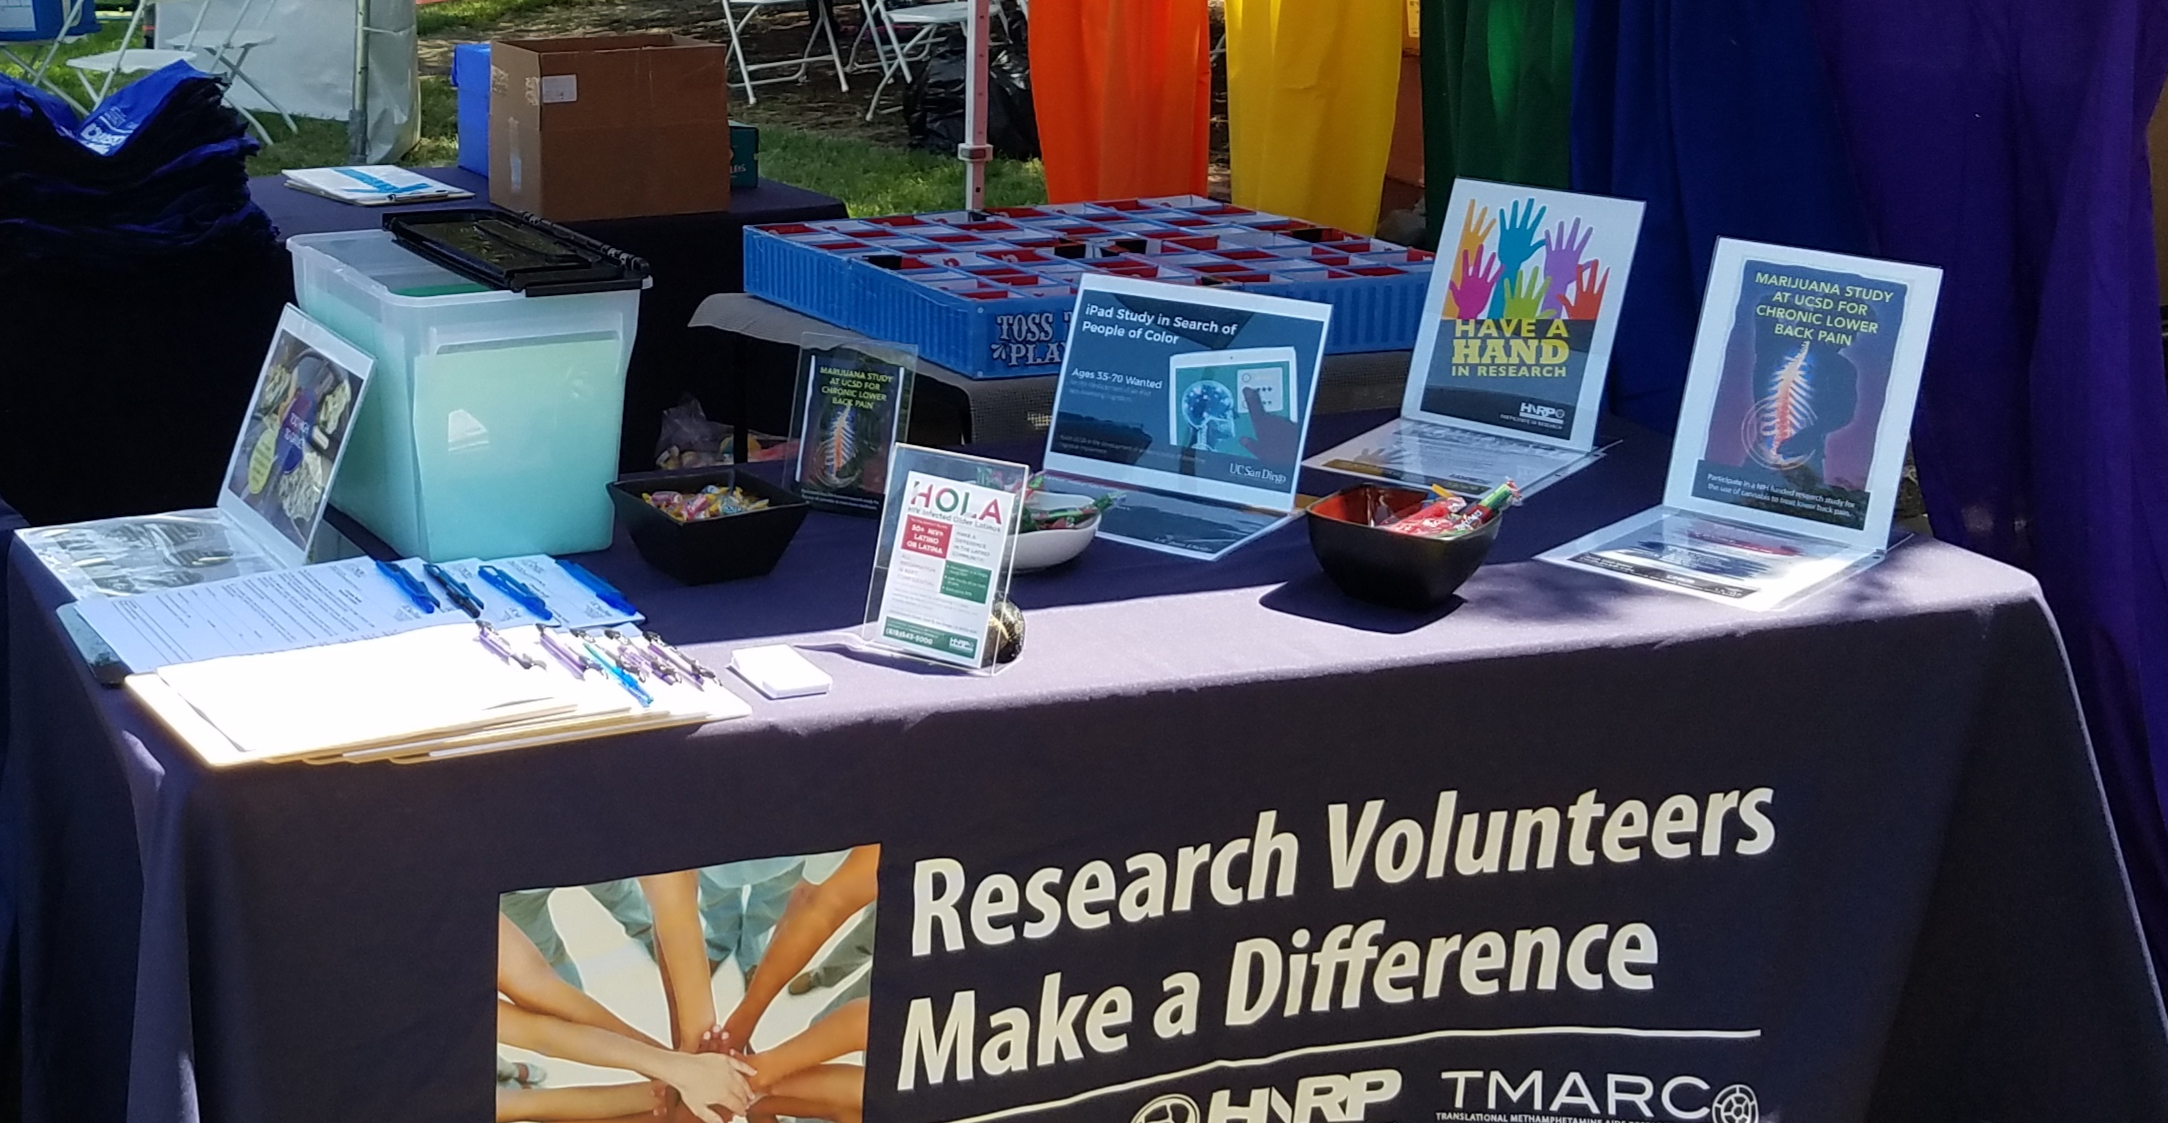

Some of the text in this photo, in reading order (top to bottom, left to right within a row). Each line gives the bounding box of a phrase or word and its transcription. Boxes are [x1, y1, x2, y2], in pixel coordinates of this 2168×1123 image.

[1755, 272, 1894, 302] MARIJUANA STUDY
[1772, 291, 1868, 315] AT UCSD FOR
[996, 312, 1053, 342] TOSS
[1085, 304, 1237, 335] iPad Study in Search of
[1455, 318, 1569, 337] HAVE A
[1756, 305, 1878, 334] CHRONIC LOWER
[1082, 321, 1125, 337] People
[1128, 327, 1142, 339] of
[1144, 330, 1180, 345] Color
[1774, 324, 1852, 346] BACK PAIN
[1452, 339, 1570, 364] HAND
[820, 366, 894, 383] MARIJUANA STUDY
[1071, 368, 1095, 379] Ages
[1096, 371, 1124, 383] 35-70
[1125, 375, 1163, 389] Wanted
[1452, 366, 1567, 377] IN RESEARCH
[821, 386, 887, 401] CHRONIC LOWER
[829, 377, 880, 390] AT UCSD FOR
[832, 397, 875, 409] BACK PAIN
[1230, 463, 1287, 484] UC San Diego
[910, 481, 1002, 525] HOLA
[907, 506, 921, 514] HIV
[953, 515, 973, 526] Older
[906, 540, 943, 555] OR LATINA
[914, 533, 939, 545] LATINO
[911, 786, 1777, 957] Research Volunteers
[897, 919, 1659, 1092] Make a Difference
[1441, 1070, 1710, 1119] TMARC
[1436, 1112, 1508, 1122] TRANSLATIONAL
